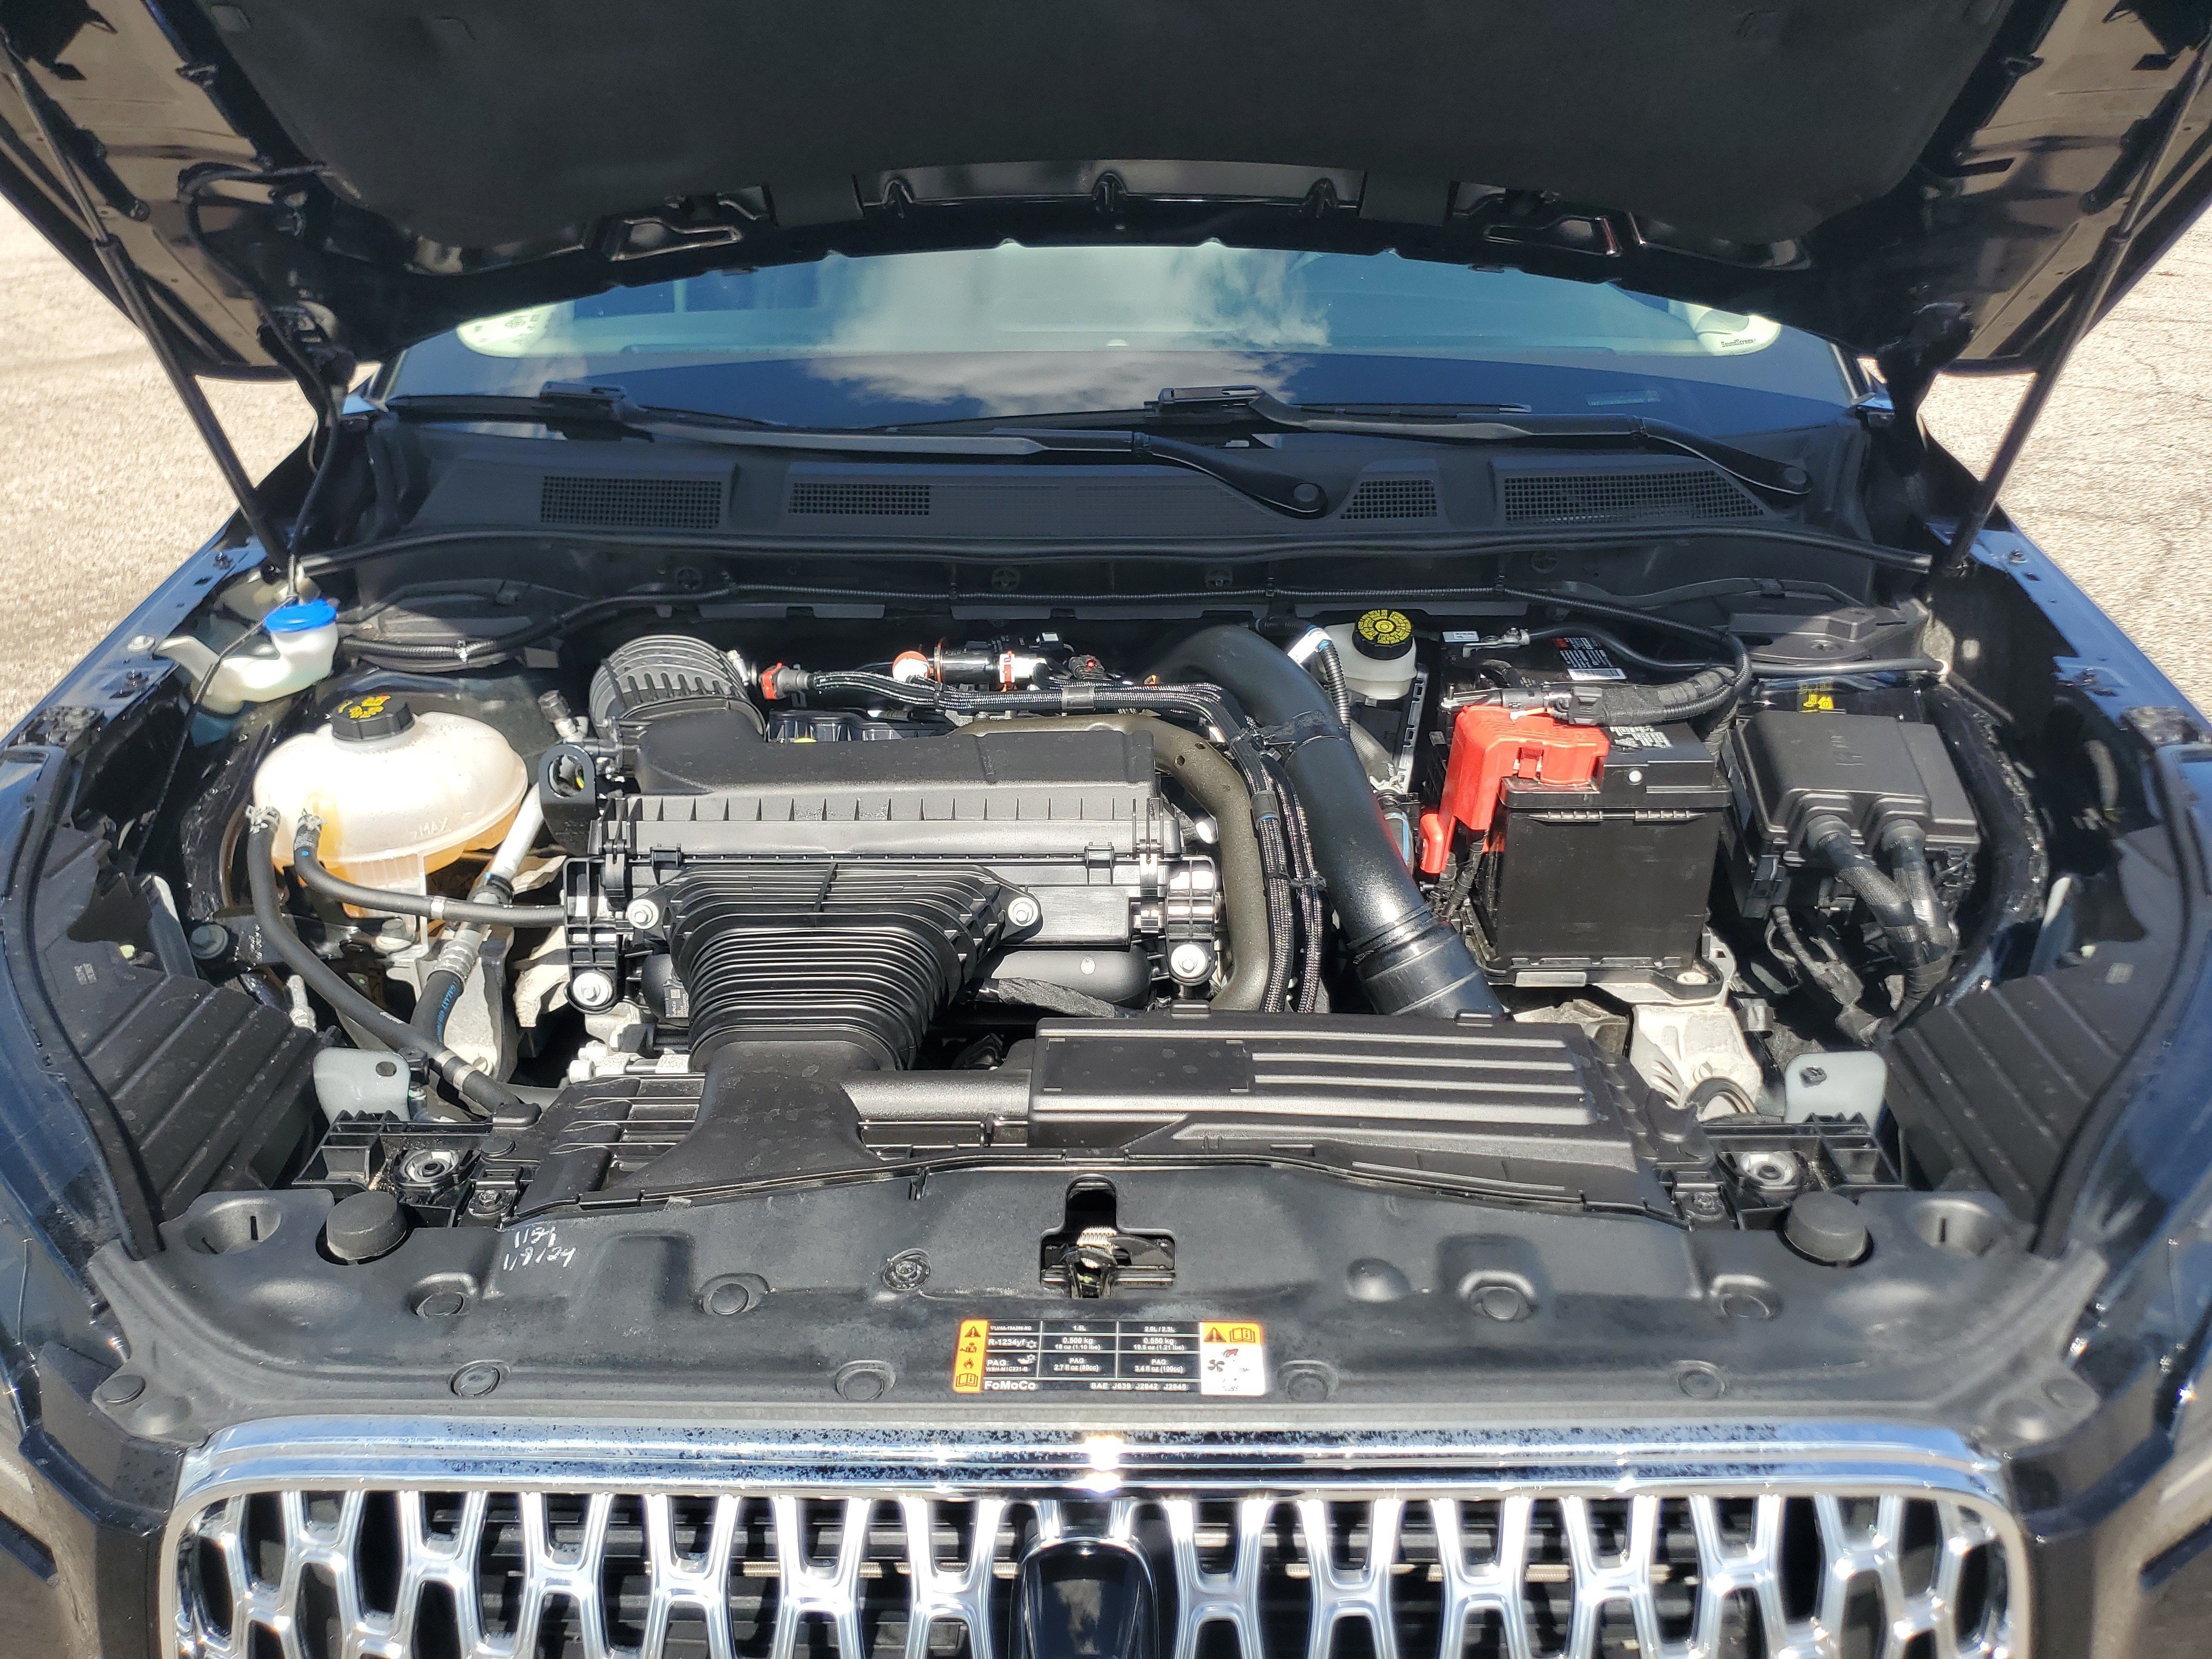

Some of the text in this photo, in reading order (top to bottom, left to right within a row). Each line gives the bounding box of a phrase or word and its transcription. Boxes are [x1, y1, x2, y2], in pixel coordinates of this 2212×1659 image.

[1720, 339, 1754, 347] SoundScreen
[988, 1338, 1025, 1347] R-1234yf
[1165, 1338, 1174, 1346] kg
[984, 1380, 1036, 1390] FoMoCo
